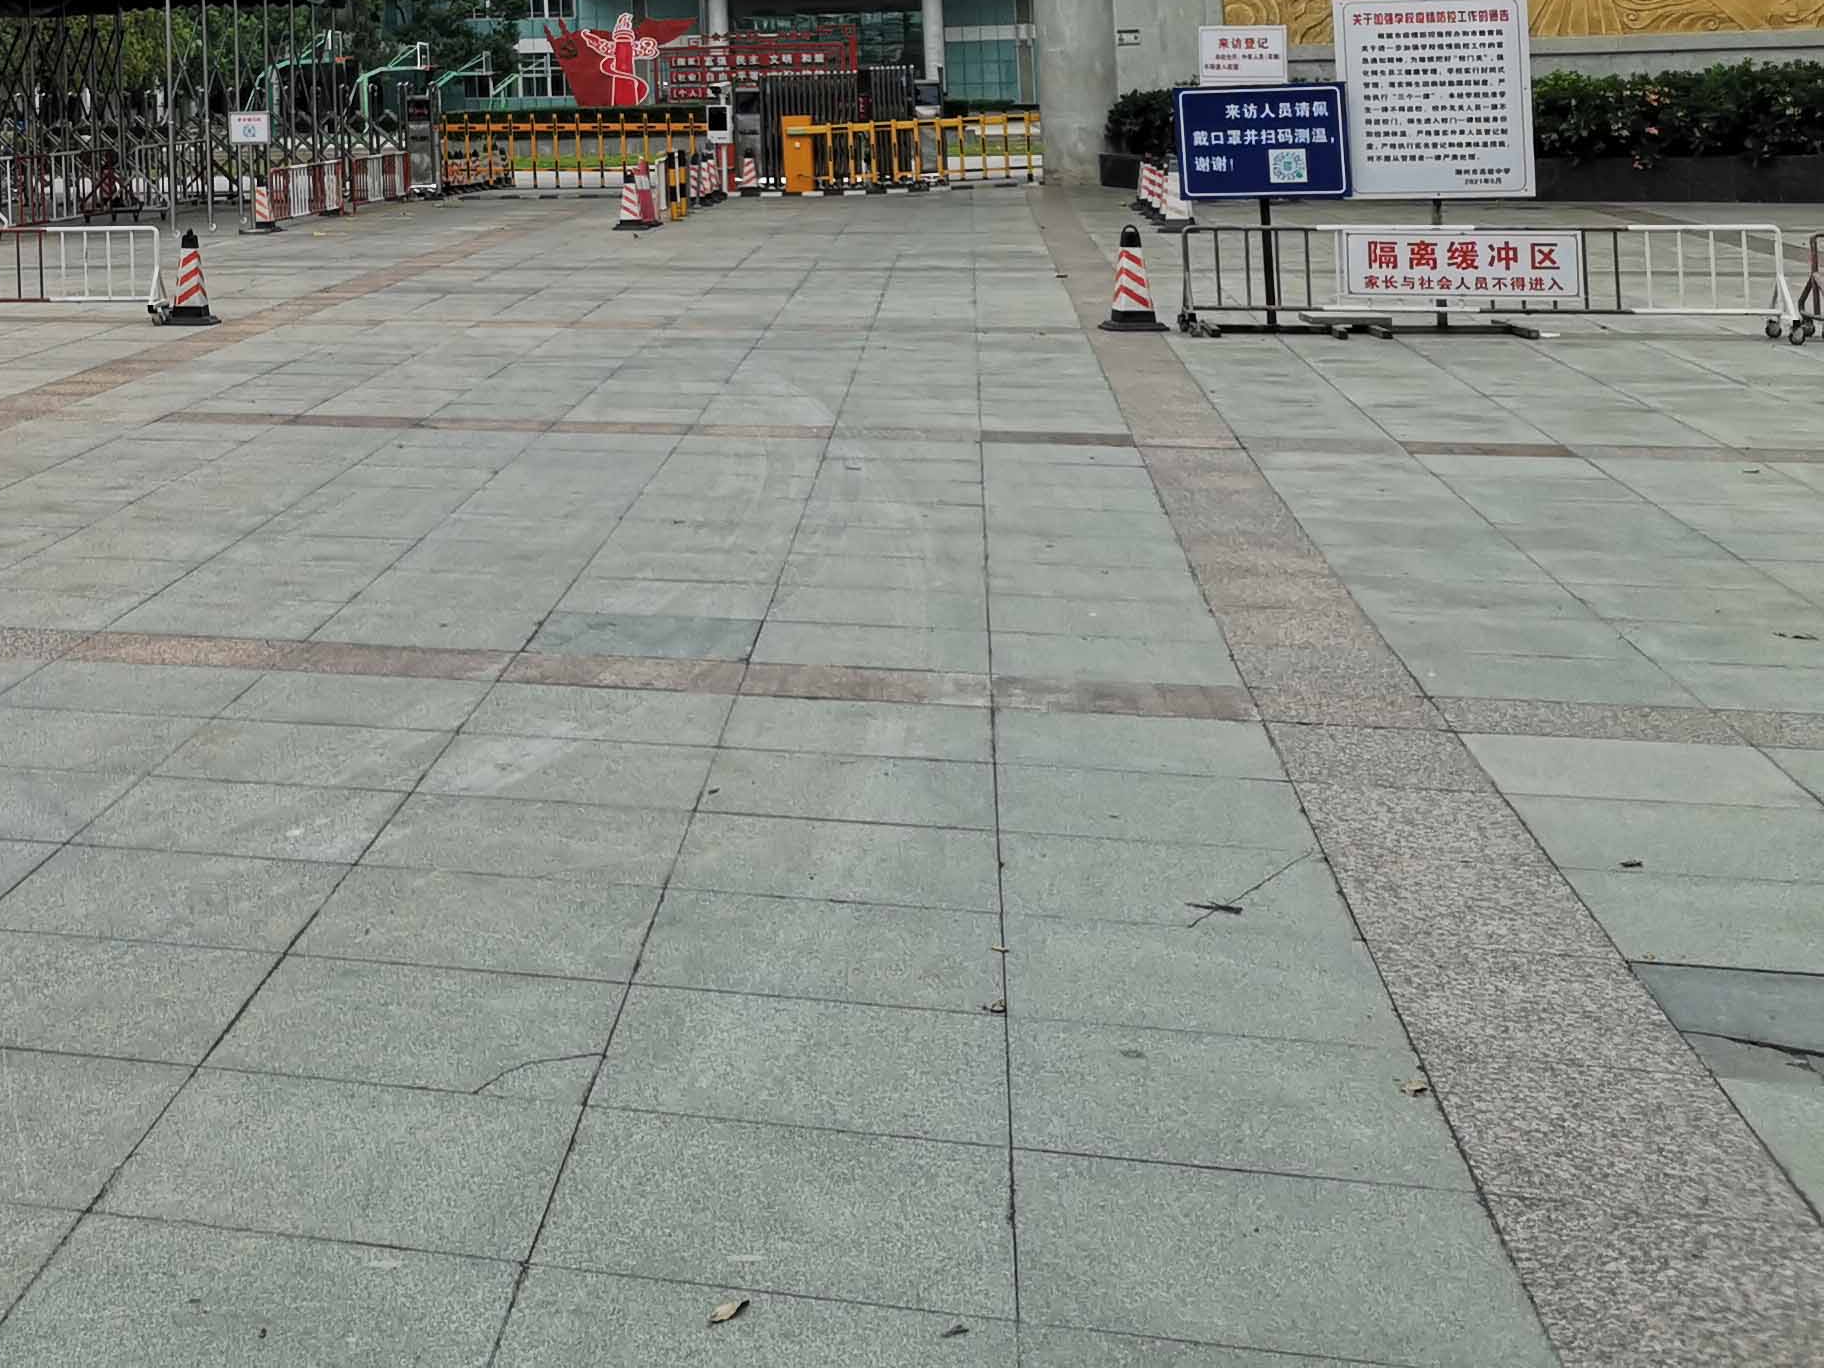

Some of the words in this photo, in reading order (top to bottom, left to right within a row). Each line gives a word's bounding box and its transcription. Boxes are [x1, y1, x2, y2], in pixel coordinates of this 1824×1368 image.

[1218, 37, 1269, 50] 来访登记
[1225, 101, 1329, 119] 来访人员请佩
[1367, 240, 1561, 271] 隔离缓冲区
[1363, 274, 1564, 291] 家长与社会人员不得进入
